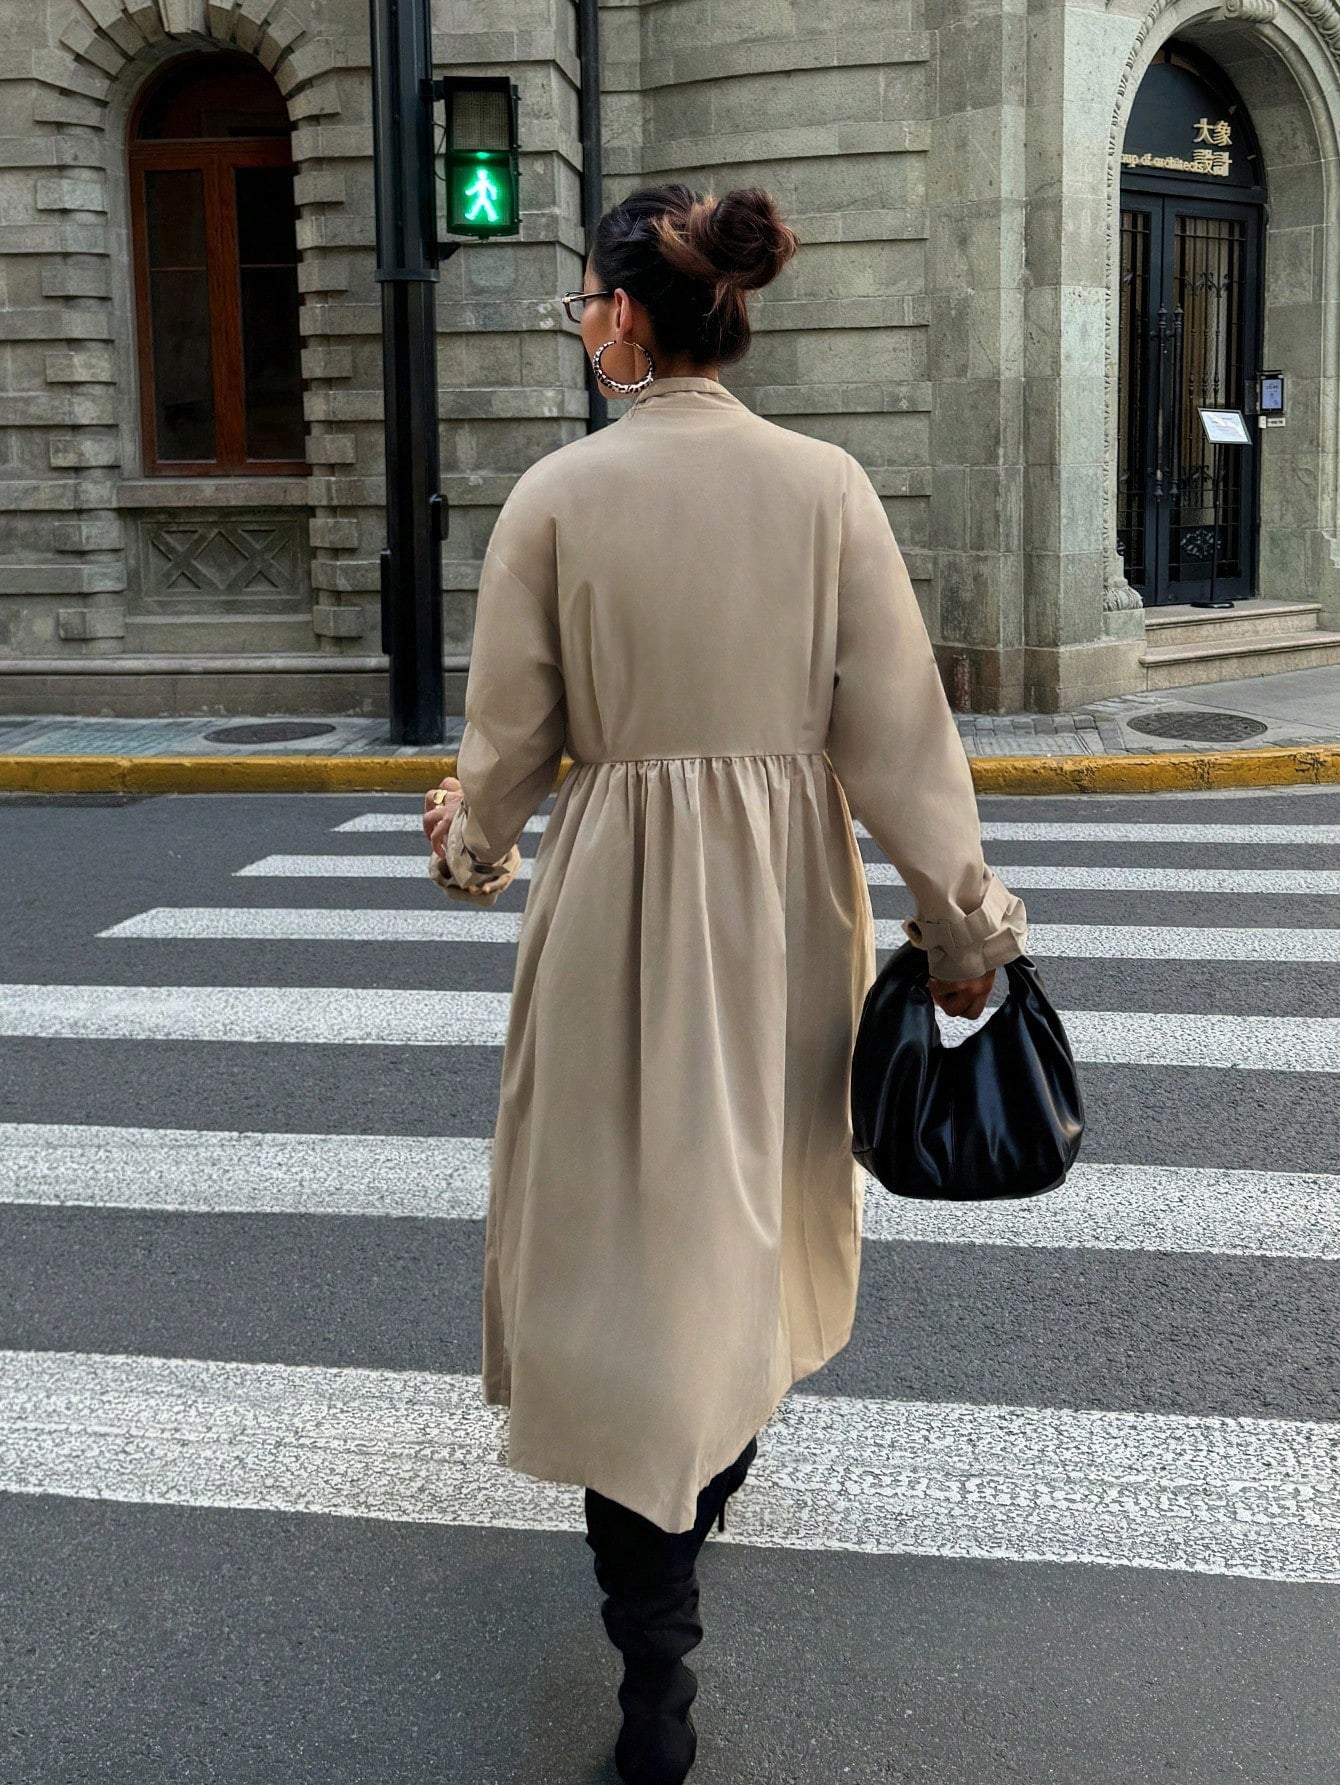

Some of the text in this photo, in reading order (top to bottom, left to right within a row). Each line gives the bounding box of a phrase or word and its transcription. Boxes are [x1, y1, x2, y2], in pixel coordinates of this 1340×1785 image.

[1193, 117, 1232, 146] 大象
[1141, 153, 1152, 166] of
[1154, 157, 1204, 174] architects
[1193, 149, 1233, 177] 設計
